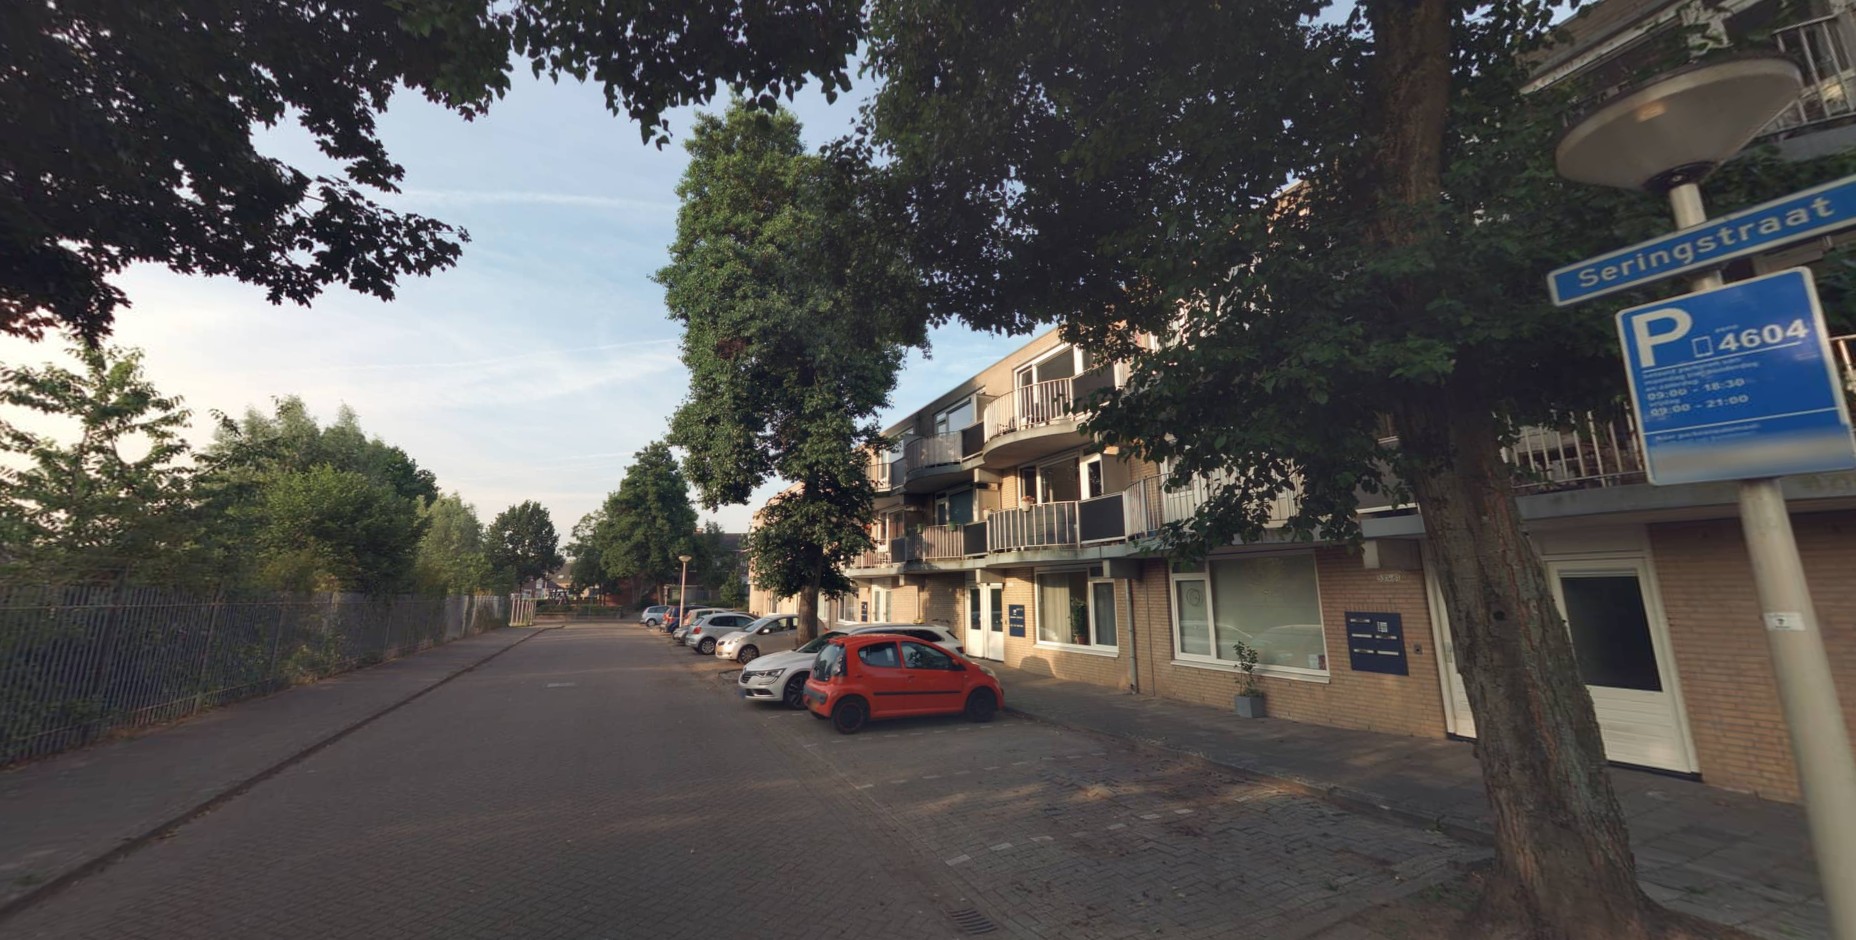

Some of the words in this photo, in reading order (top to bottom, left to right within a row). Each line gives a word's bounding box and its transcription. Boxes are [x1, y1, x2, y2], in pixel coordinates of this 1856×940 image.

[1578, 197, 1835, 288] Seringstraat
[1631, 307, 1693, 368] P
[1718, 318, 1809, 351] 4604
[1647, 388, 1687, 401] 09:00
[1704, 378, 1745, 391] 18:30
[1650, 404, 1691, 416] 09:00
[1707, 395, 1749, 407] 21:00
